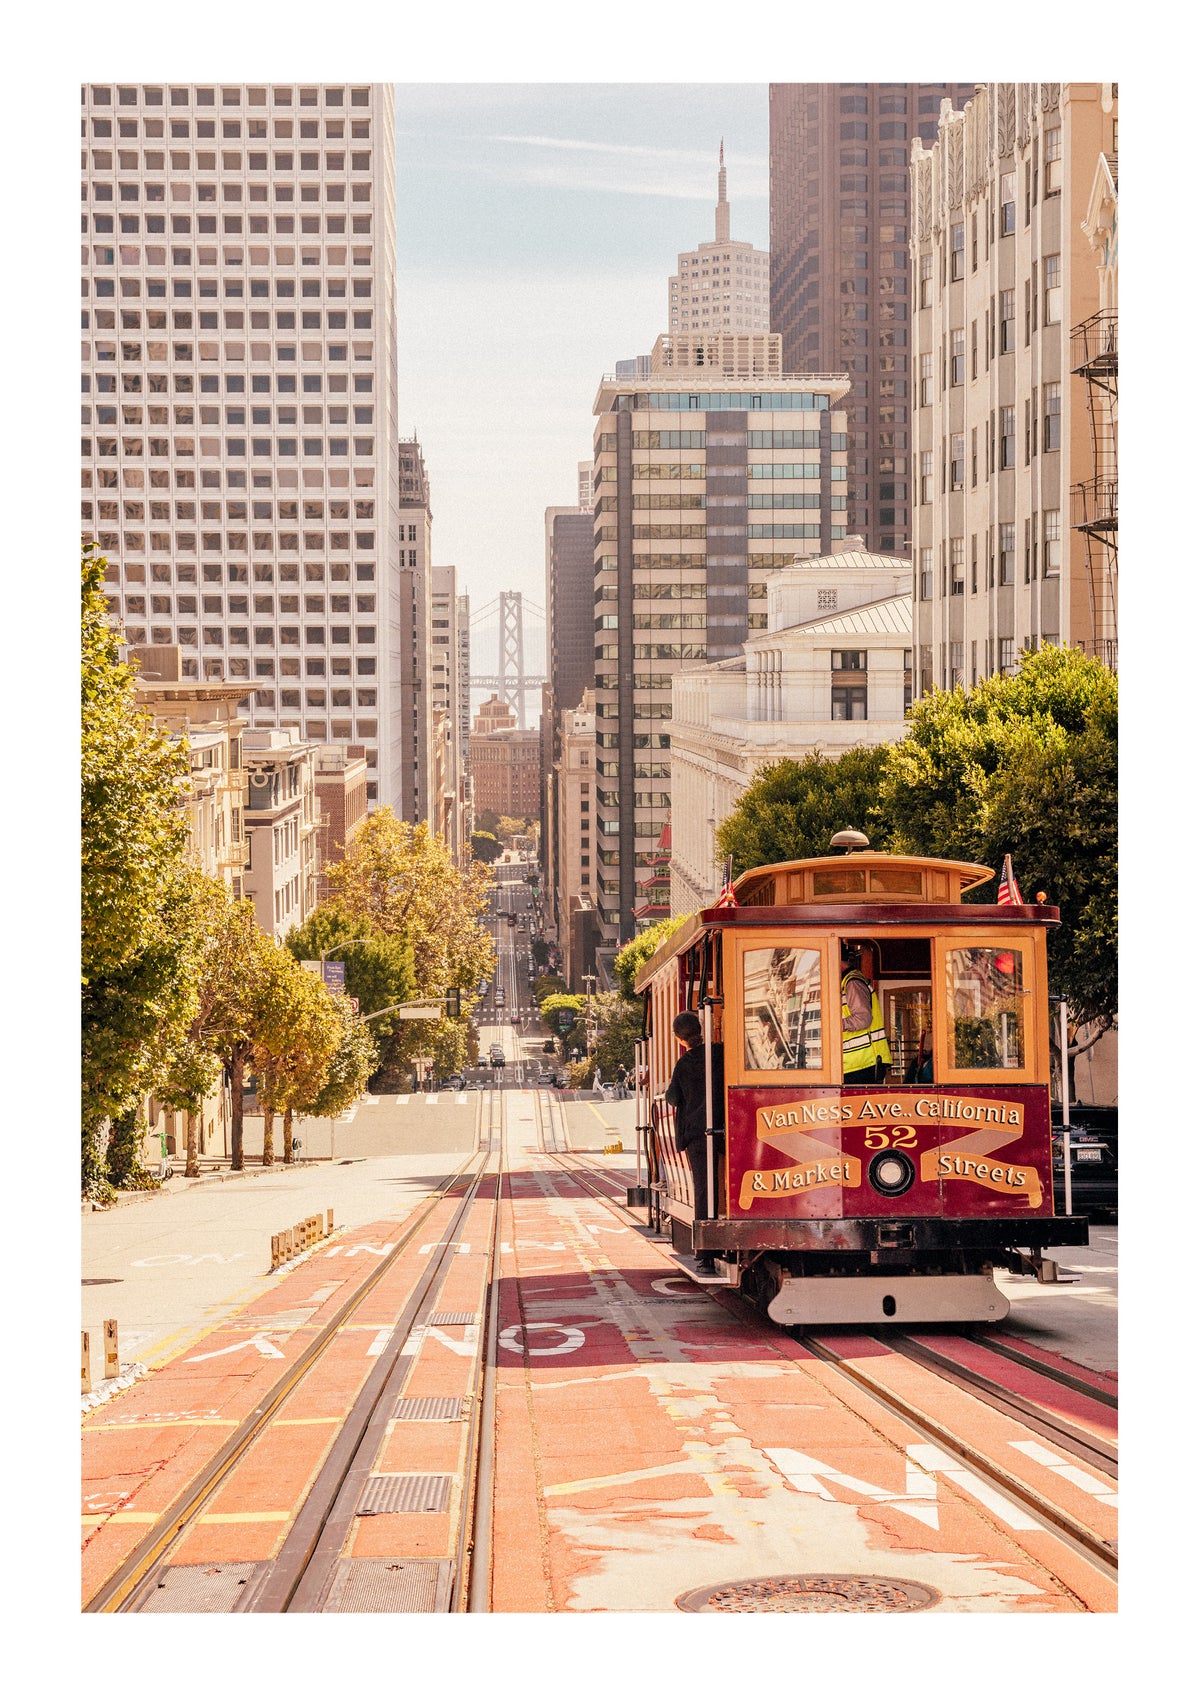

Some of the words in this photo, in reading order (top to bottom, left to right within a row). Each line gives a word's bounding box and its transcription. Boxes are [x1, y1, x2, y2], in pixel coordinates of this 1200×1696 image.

[761, 1110, 799, 1129] Van
[800, 1103, 852, 1123] Ness
[915, 1099, 1020, 1125] California
[864, 1125, 918, 1149] 52
[752, 1172, 768, 1191] &
[772, 1162, 850, 1191] Market
[938, 1156, 1027, 1187] Streets
